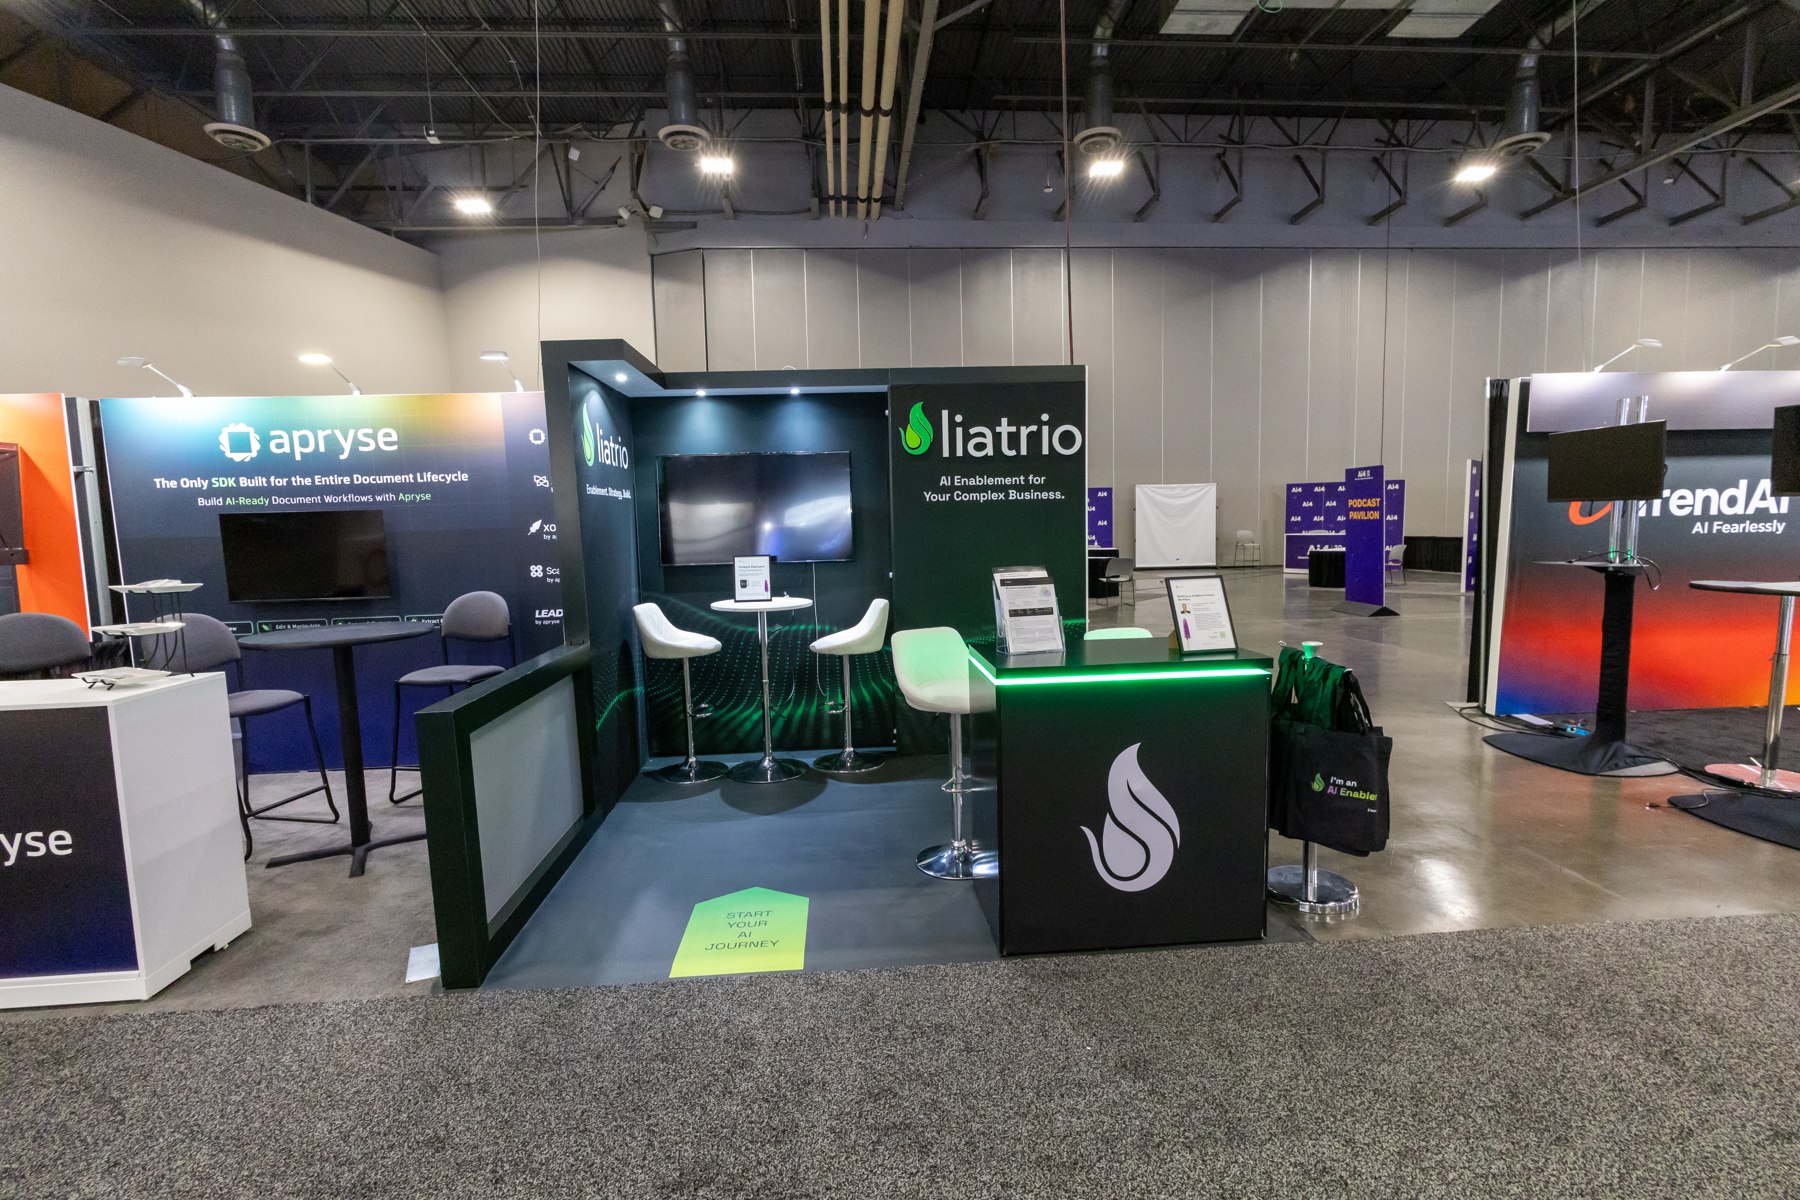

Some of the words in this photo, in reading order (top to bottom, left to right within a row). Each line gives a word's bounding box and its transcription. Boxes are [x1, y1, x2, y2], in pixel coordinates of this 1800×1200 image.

[942, 410, 1082, 458] liatrio
[269, 427, 398, 460] apryse
[596, 422, 629, 470] liatrio
[153, 478, 178, 488] The
[180, 477, 209, 490] Only
[211, 477, 237, 488] SDK
[239, 476, 268, 487] Built
[270, 475, 288, 486] for
[291, 475, 312, 486] the
[315, 474, 351, 485] Entire
[353, 473, 414, 485] Document
[417, 471, 469, 484] Lifecycle
[939, 475, 951, 487] AI
[954, 475, 1025, 486] Enablement
[1028, 474, 1046, 485] for
[198, 497, 223, 506] Build
[225, 496, 269, 507] AI-Ready
[272, 495, 321, 505] Document
[323, 493, 373, 503] Workflows
[375, 492, 396, 502] with
[398, 492, 432, 503] Apryse
[923, 491, 951, 502] Your
[953, 490, 1005, 502] Complex
[1008, 489, 1065, 500] Business.
[1638, 478, 1790, 517] rendA
[1348, 498, 1381, 508] PODCAST
[1349, 511, 1380, 520] PAVILION
[1691, 522, 1709, 534] AI
[1712, 520, 1785, 535] Fearlessly
[1330, 776, 1344, 785] I'm
[1327, 785, 1338, 795] AI
[726, 910, 773, 919] START
[727, 920, 768, 928] YOUR
[705, 940, 780, 951] JOURNEY
